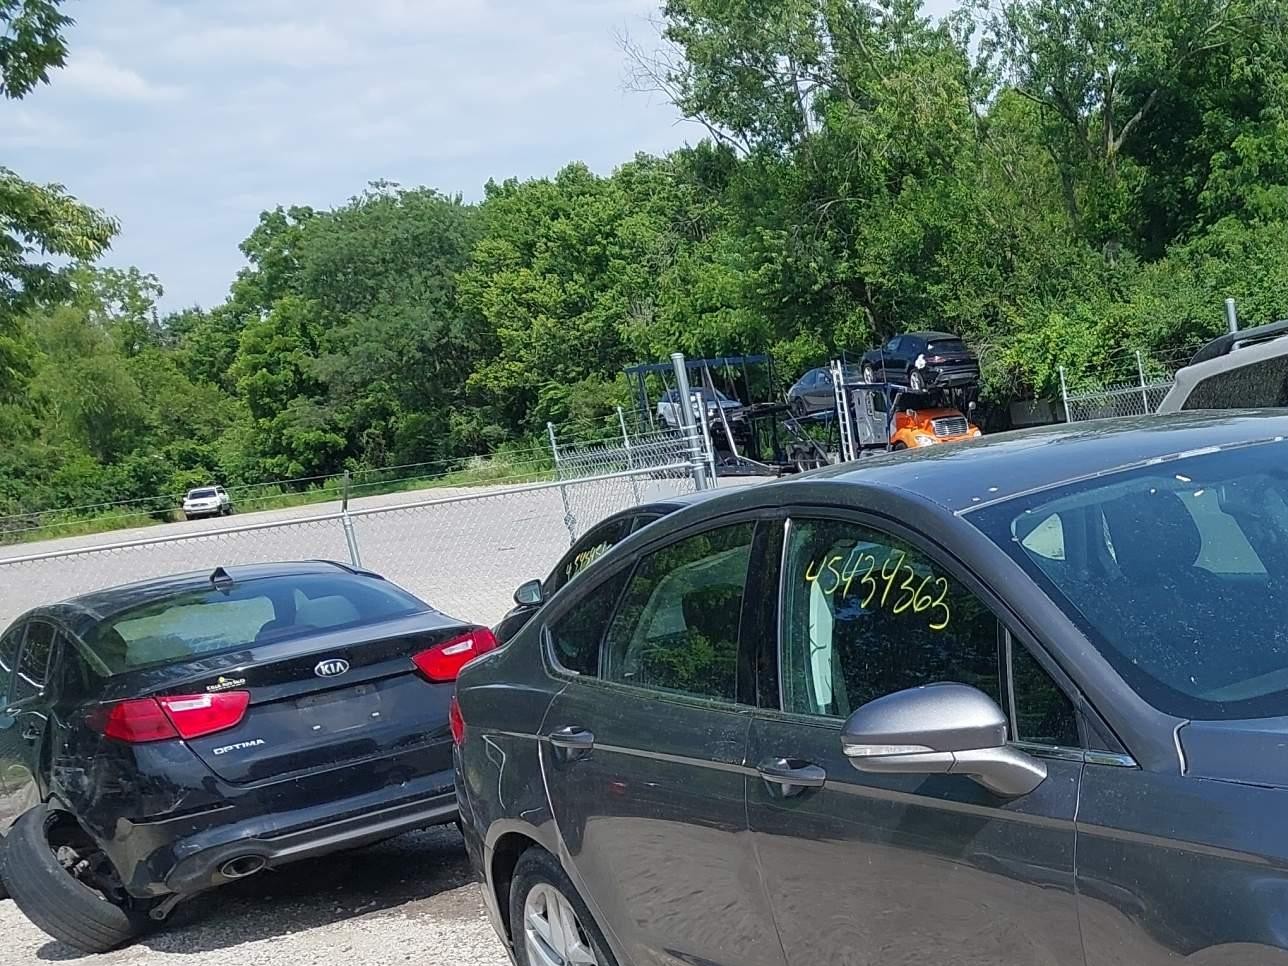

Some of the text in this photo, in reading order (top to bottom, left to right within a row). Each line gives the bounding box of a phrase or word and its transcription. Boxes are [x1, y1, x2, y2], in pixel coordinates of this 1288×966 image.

[806, 552, 950, 630] 45434363
[320, 662, 345, 675] KIA
[213, 739, 265, 755] OPTIMA
